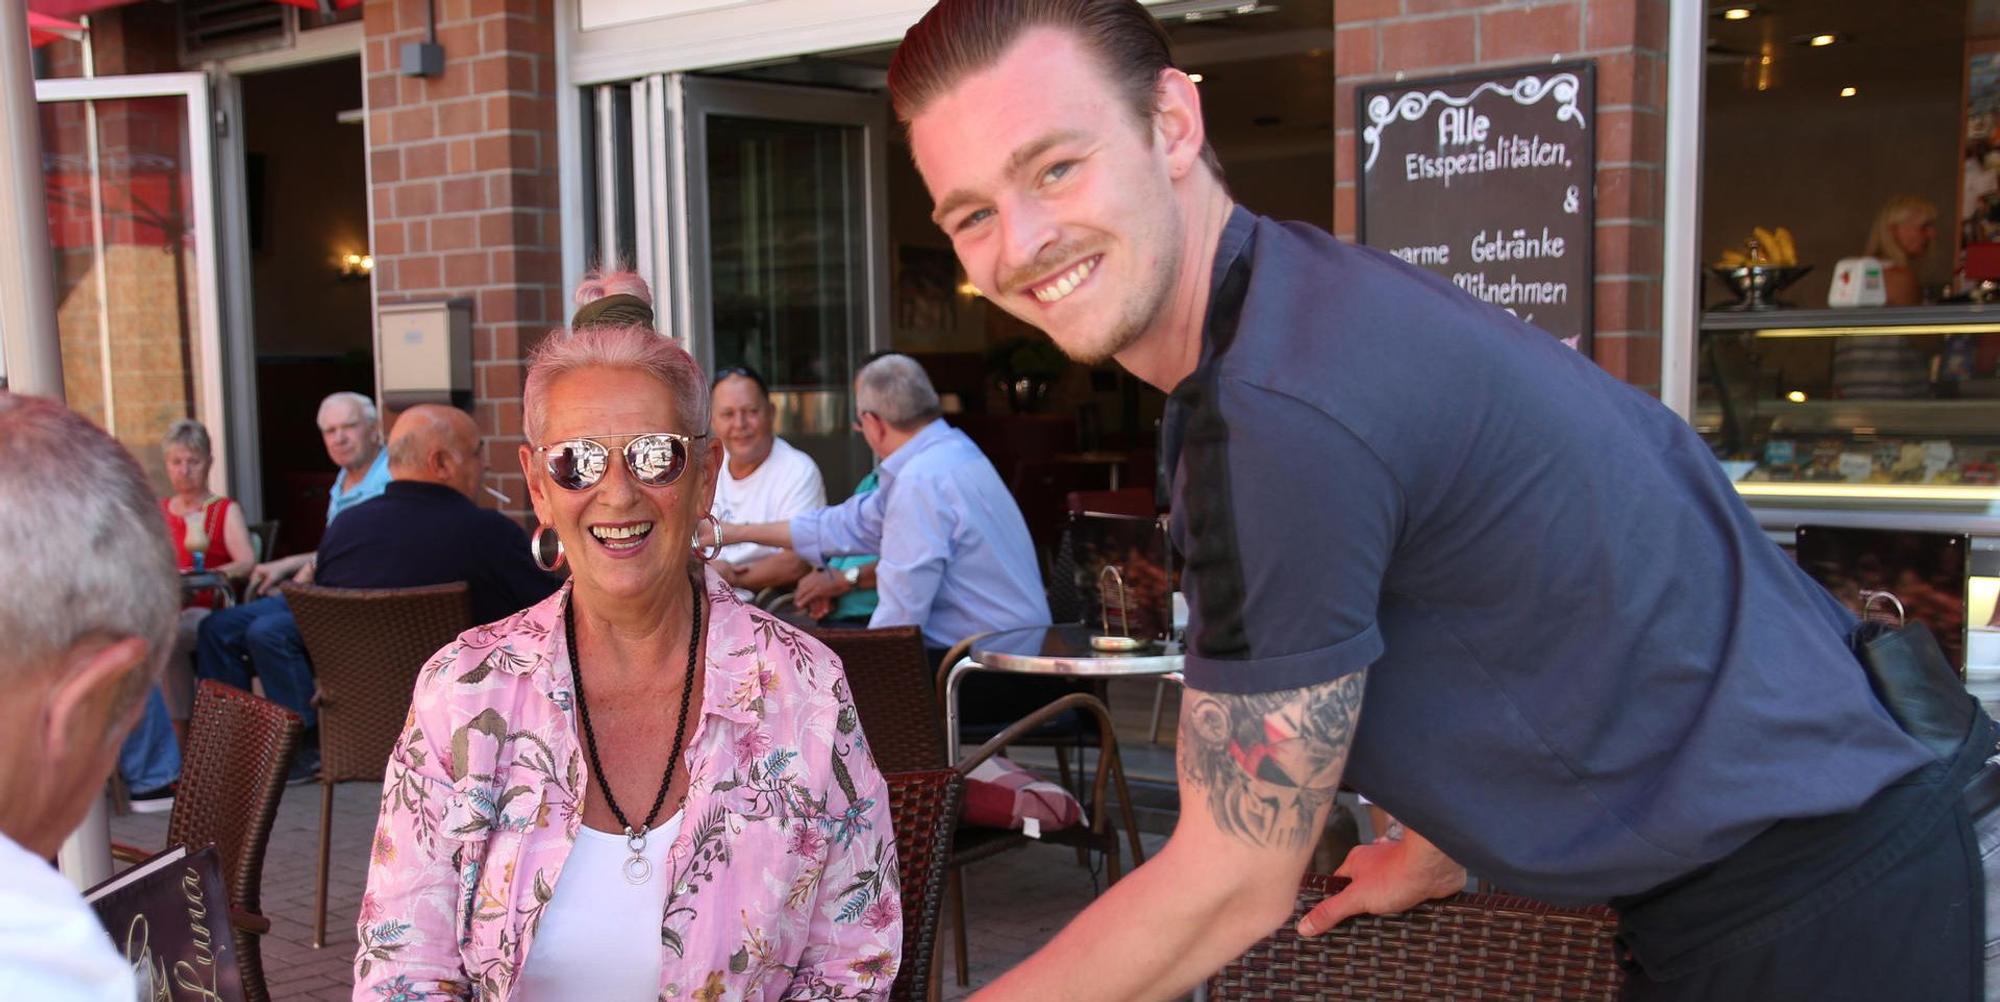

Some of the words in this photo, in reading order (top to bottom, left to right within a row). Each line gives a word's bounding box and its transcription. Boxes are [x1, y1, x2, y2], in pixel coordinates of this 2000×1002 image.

[1438, 106, 1490, 146] Alle
[1563, 184, 1580, 213] &
[1471, 226, 1565, 263] Getränke
[173, 867, 227, 1002] Luna
